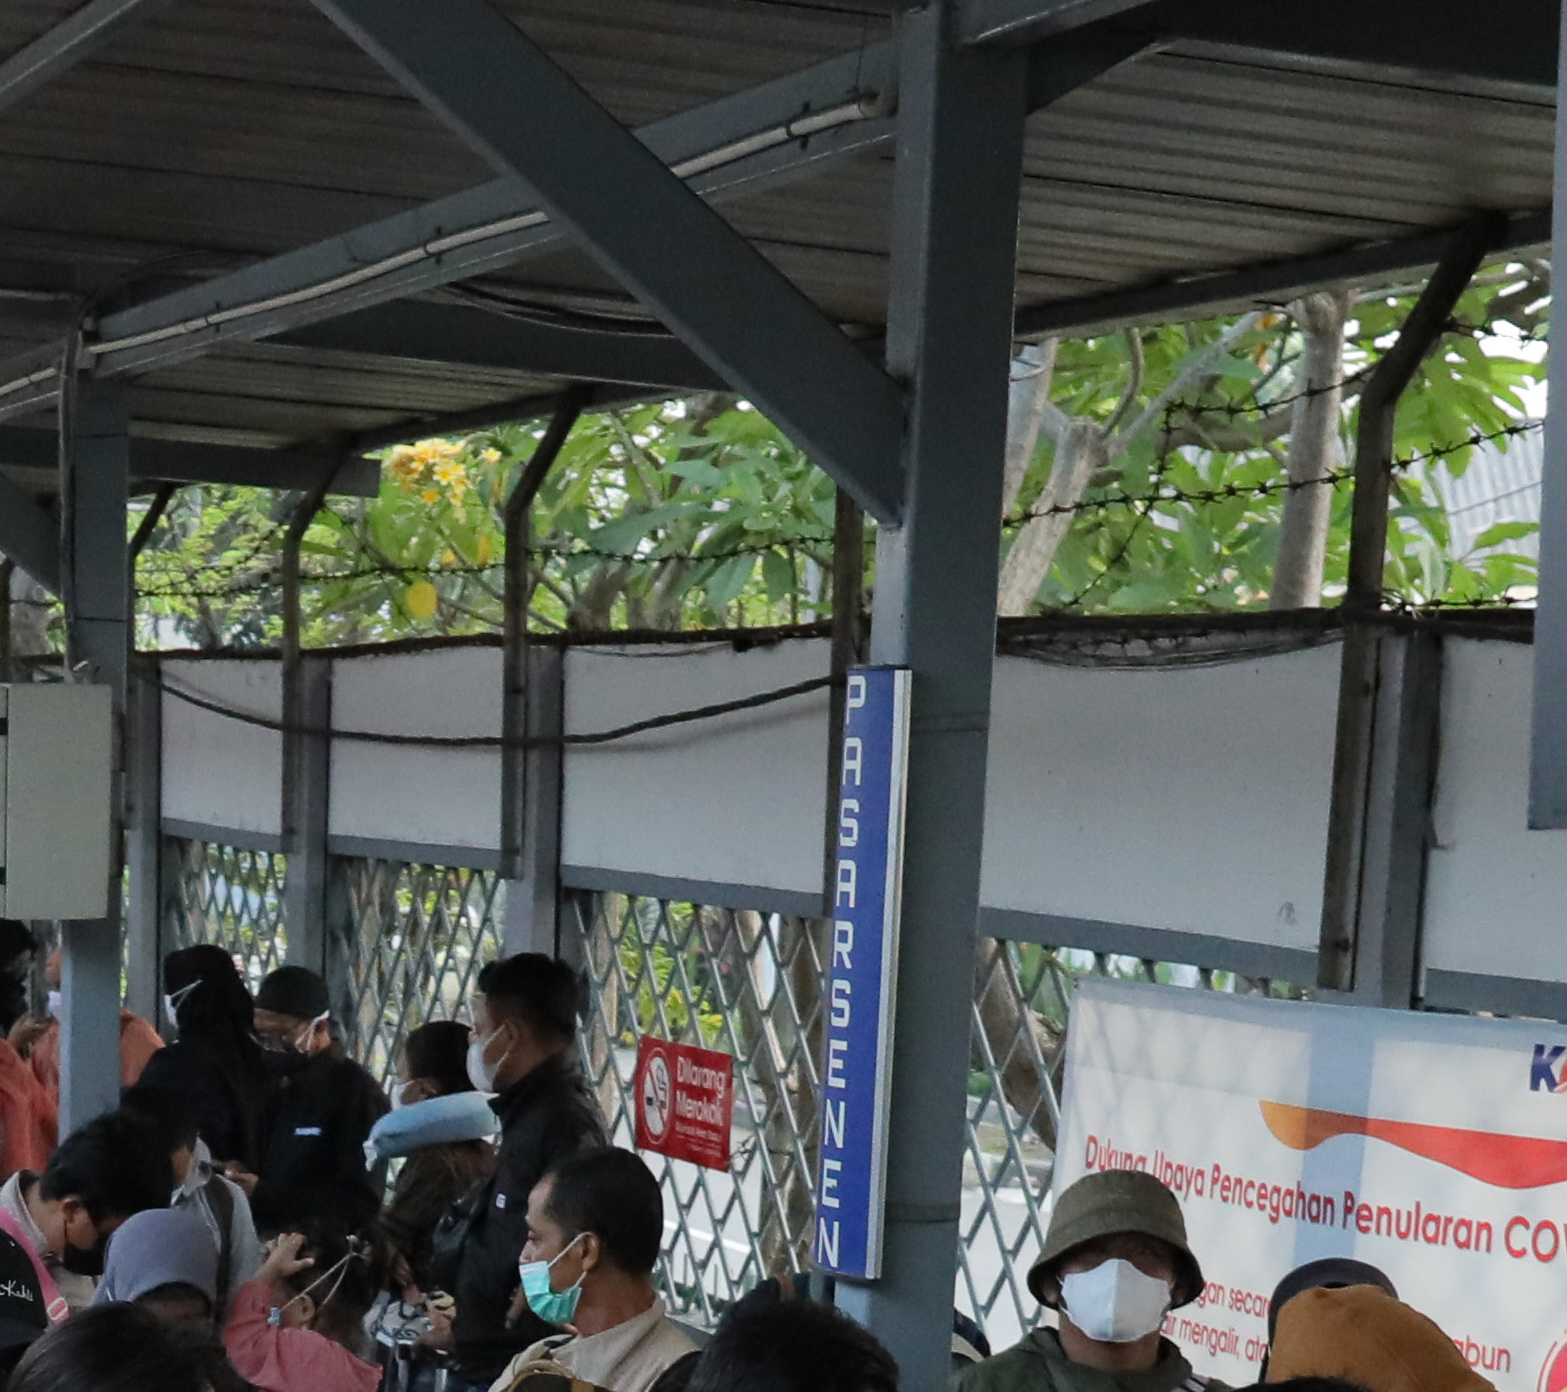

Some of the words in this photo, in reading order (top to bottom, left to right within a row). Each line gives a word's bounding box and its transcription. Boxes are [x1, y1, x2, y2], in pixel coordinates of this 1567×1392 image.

[677, 1056, 727, 1098] Dilarang
[675, 1090, 724, 1126] Merokok
[1210, 1163, 1335, 1226] Pencegahan
[1343, 1190, 1493, 1253] Penularan
